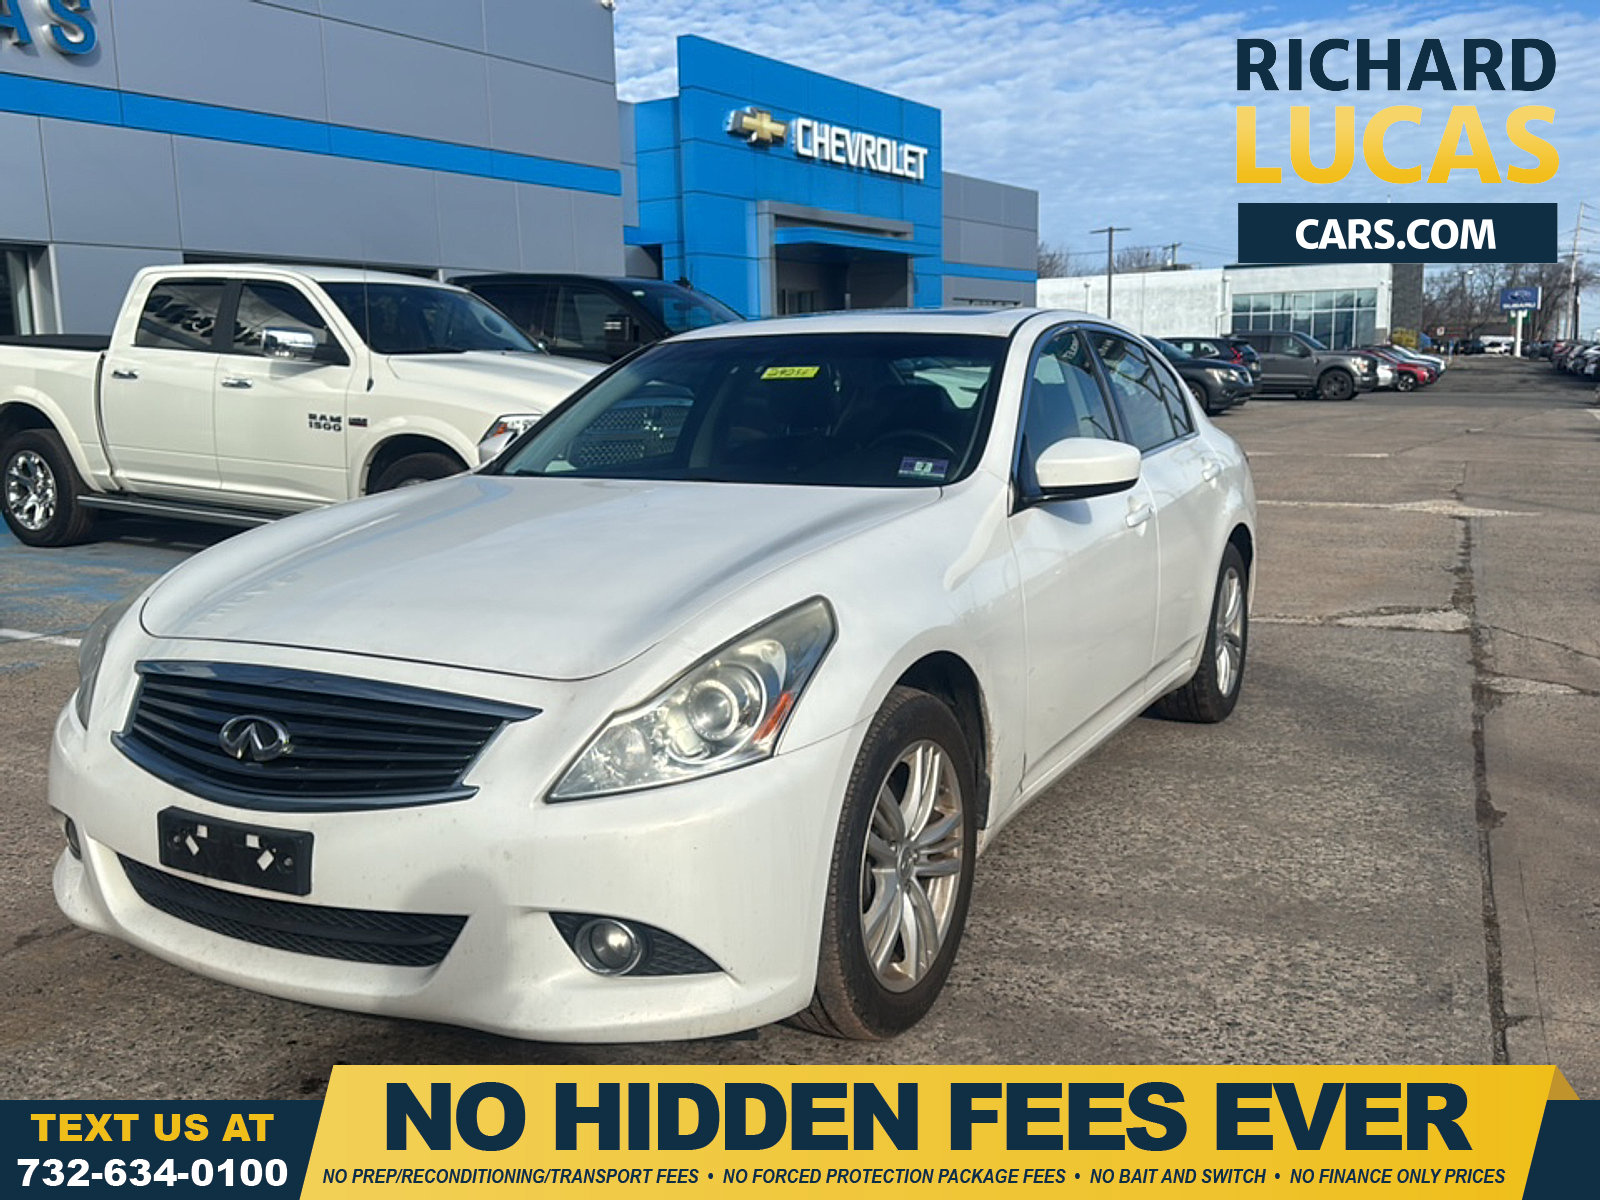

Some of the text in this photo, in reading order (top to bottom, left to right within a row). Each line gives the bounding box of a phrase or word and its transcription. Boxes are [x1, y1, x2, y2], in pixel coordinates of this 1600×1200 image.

[794, 117, 928, 179] CHEVROLET
[308, 413, 342, 422] RAM
[308, 420, 342, 431] 1500
